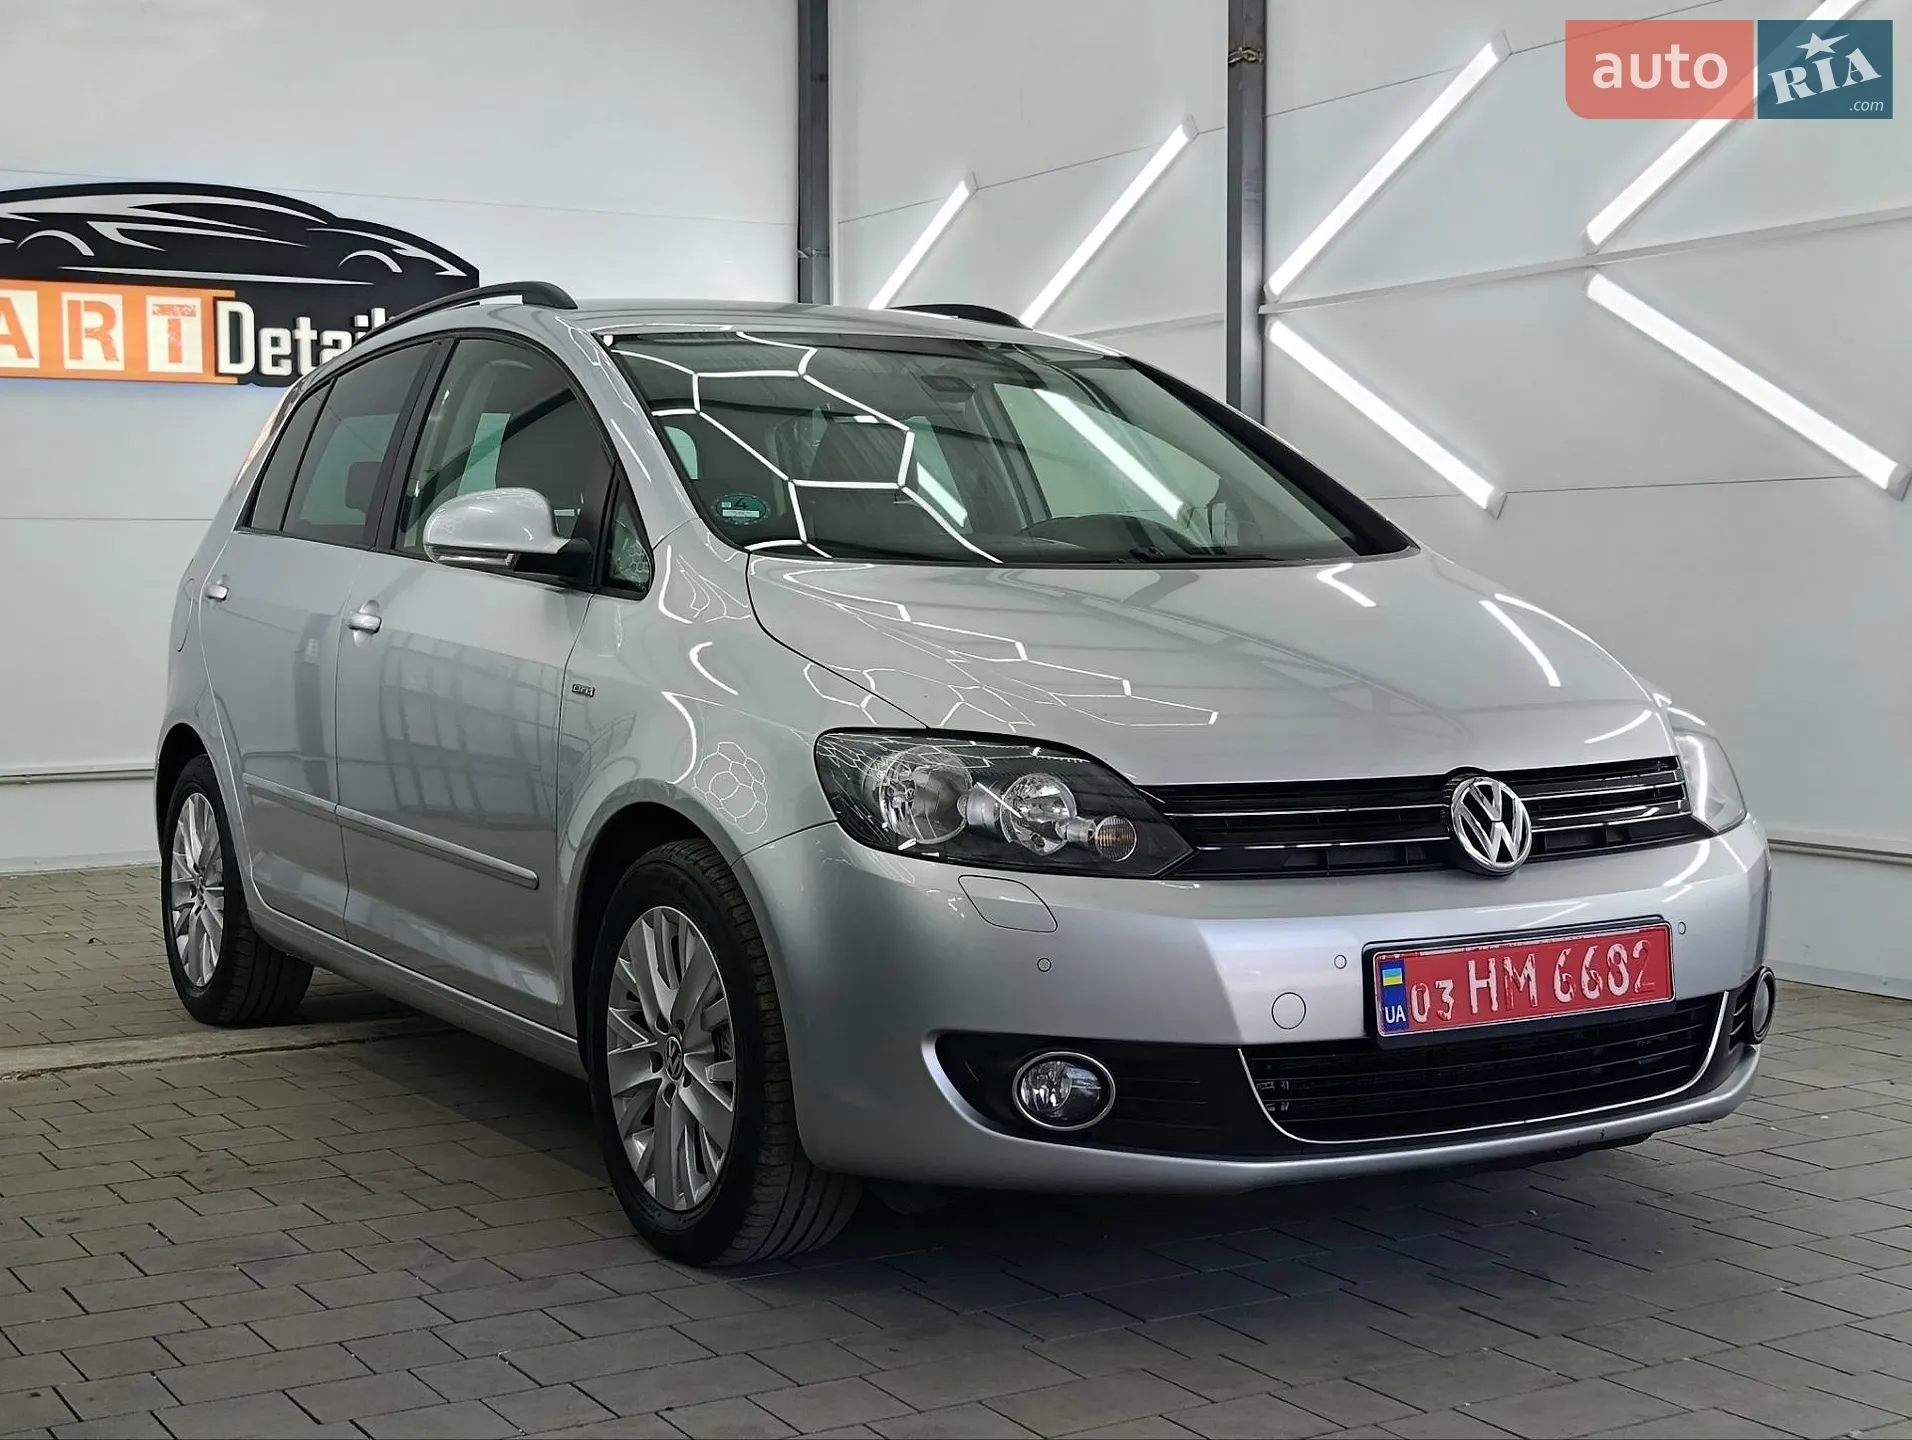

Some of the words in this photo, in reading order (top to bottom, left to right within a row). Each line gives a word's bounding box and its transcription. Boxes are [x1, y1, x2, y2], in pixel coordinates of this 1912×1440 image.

[1410, 978, 1455, 1024] 03
[1467, 953, 1539, 1015] HM
[1553, 939, 1656, 1003] 6682
[1384, 1005, 1407, 1024] UA
